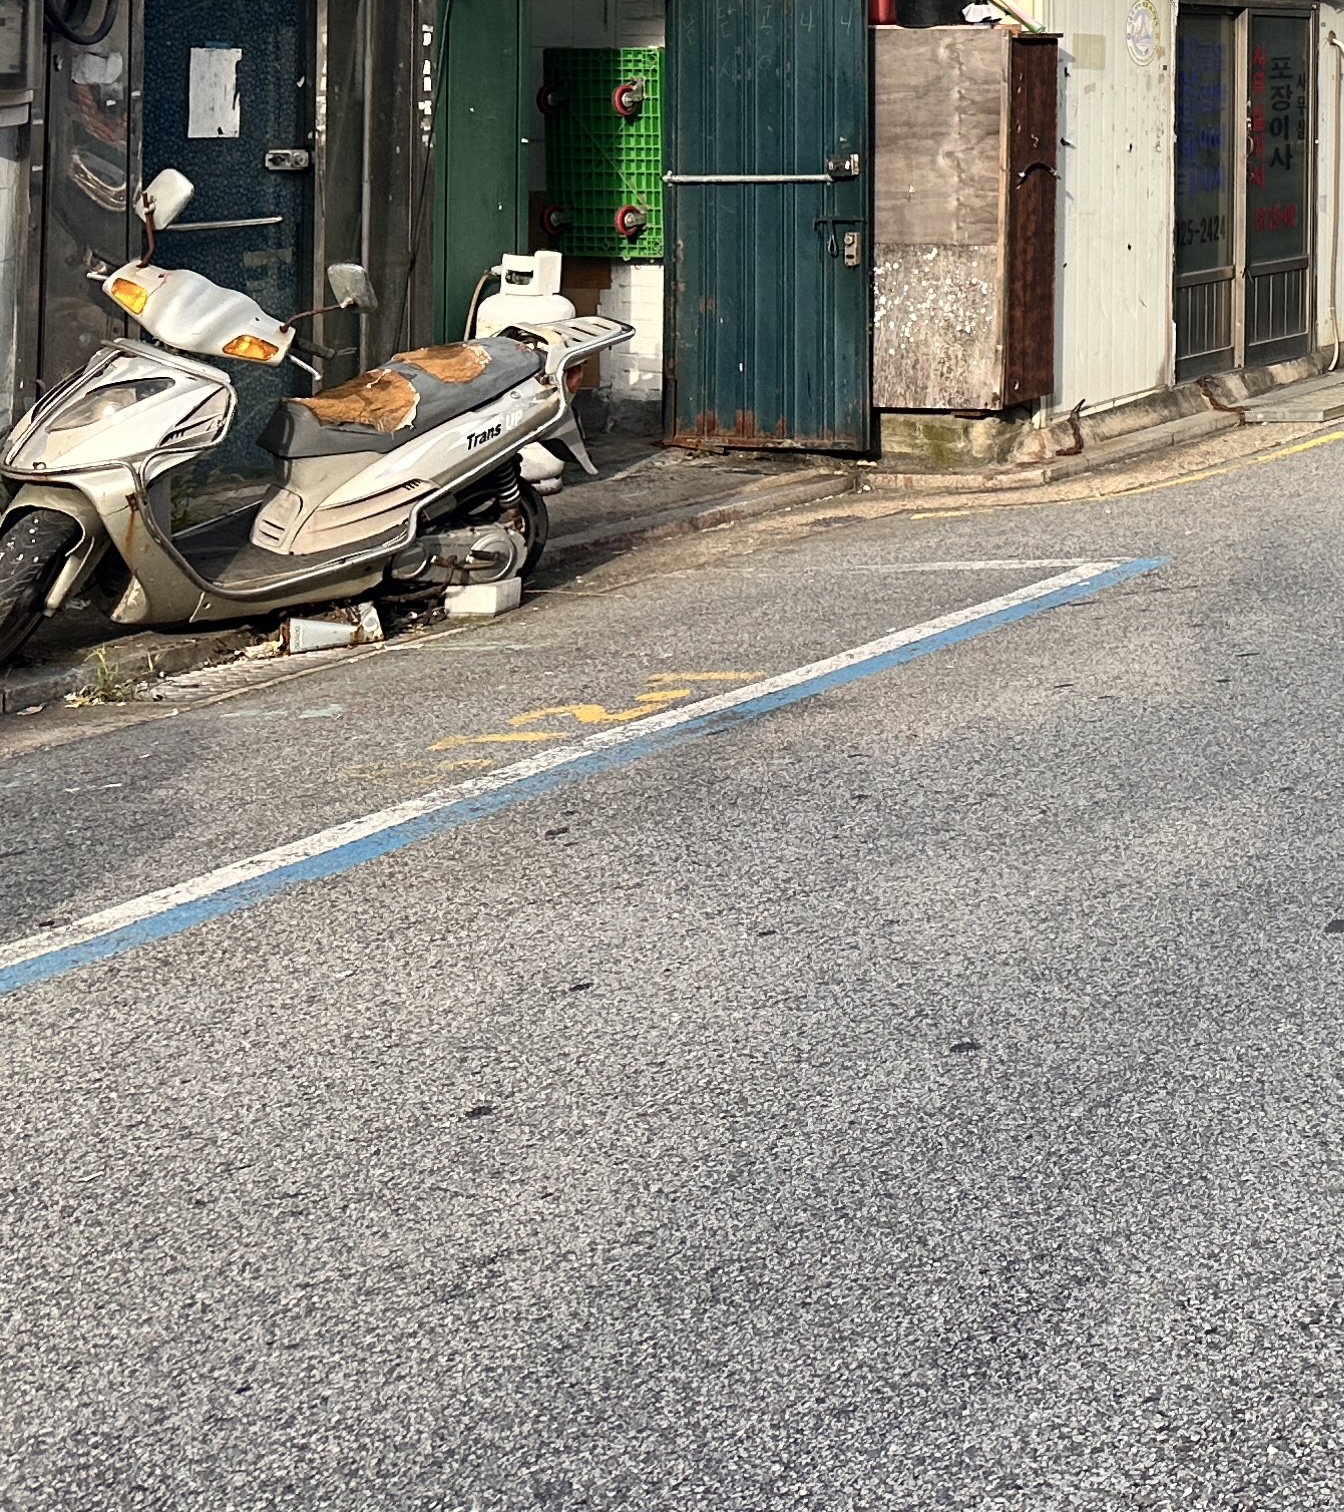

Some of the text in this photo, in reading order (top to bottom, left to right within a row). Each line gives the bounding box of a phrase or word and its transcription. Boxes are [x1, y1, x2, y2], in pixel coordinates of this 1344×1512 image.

[1268, 56, 1294, 170] 포장이사
[467, 408, 523, 451] Trans UP
